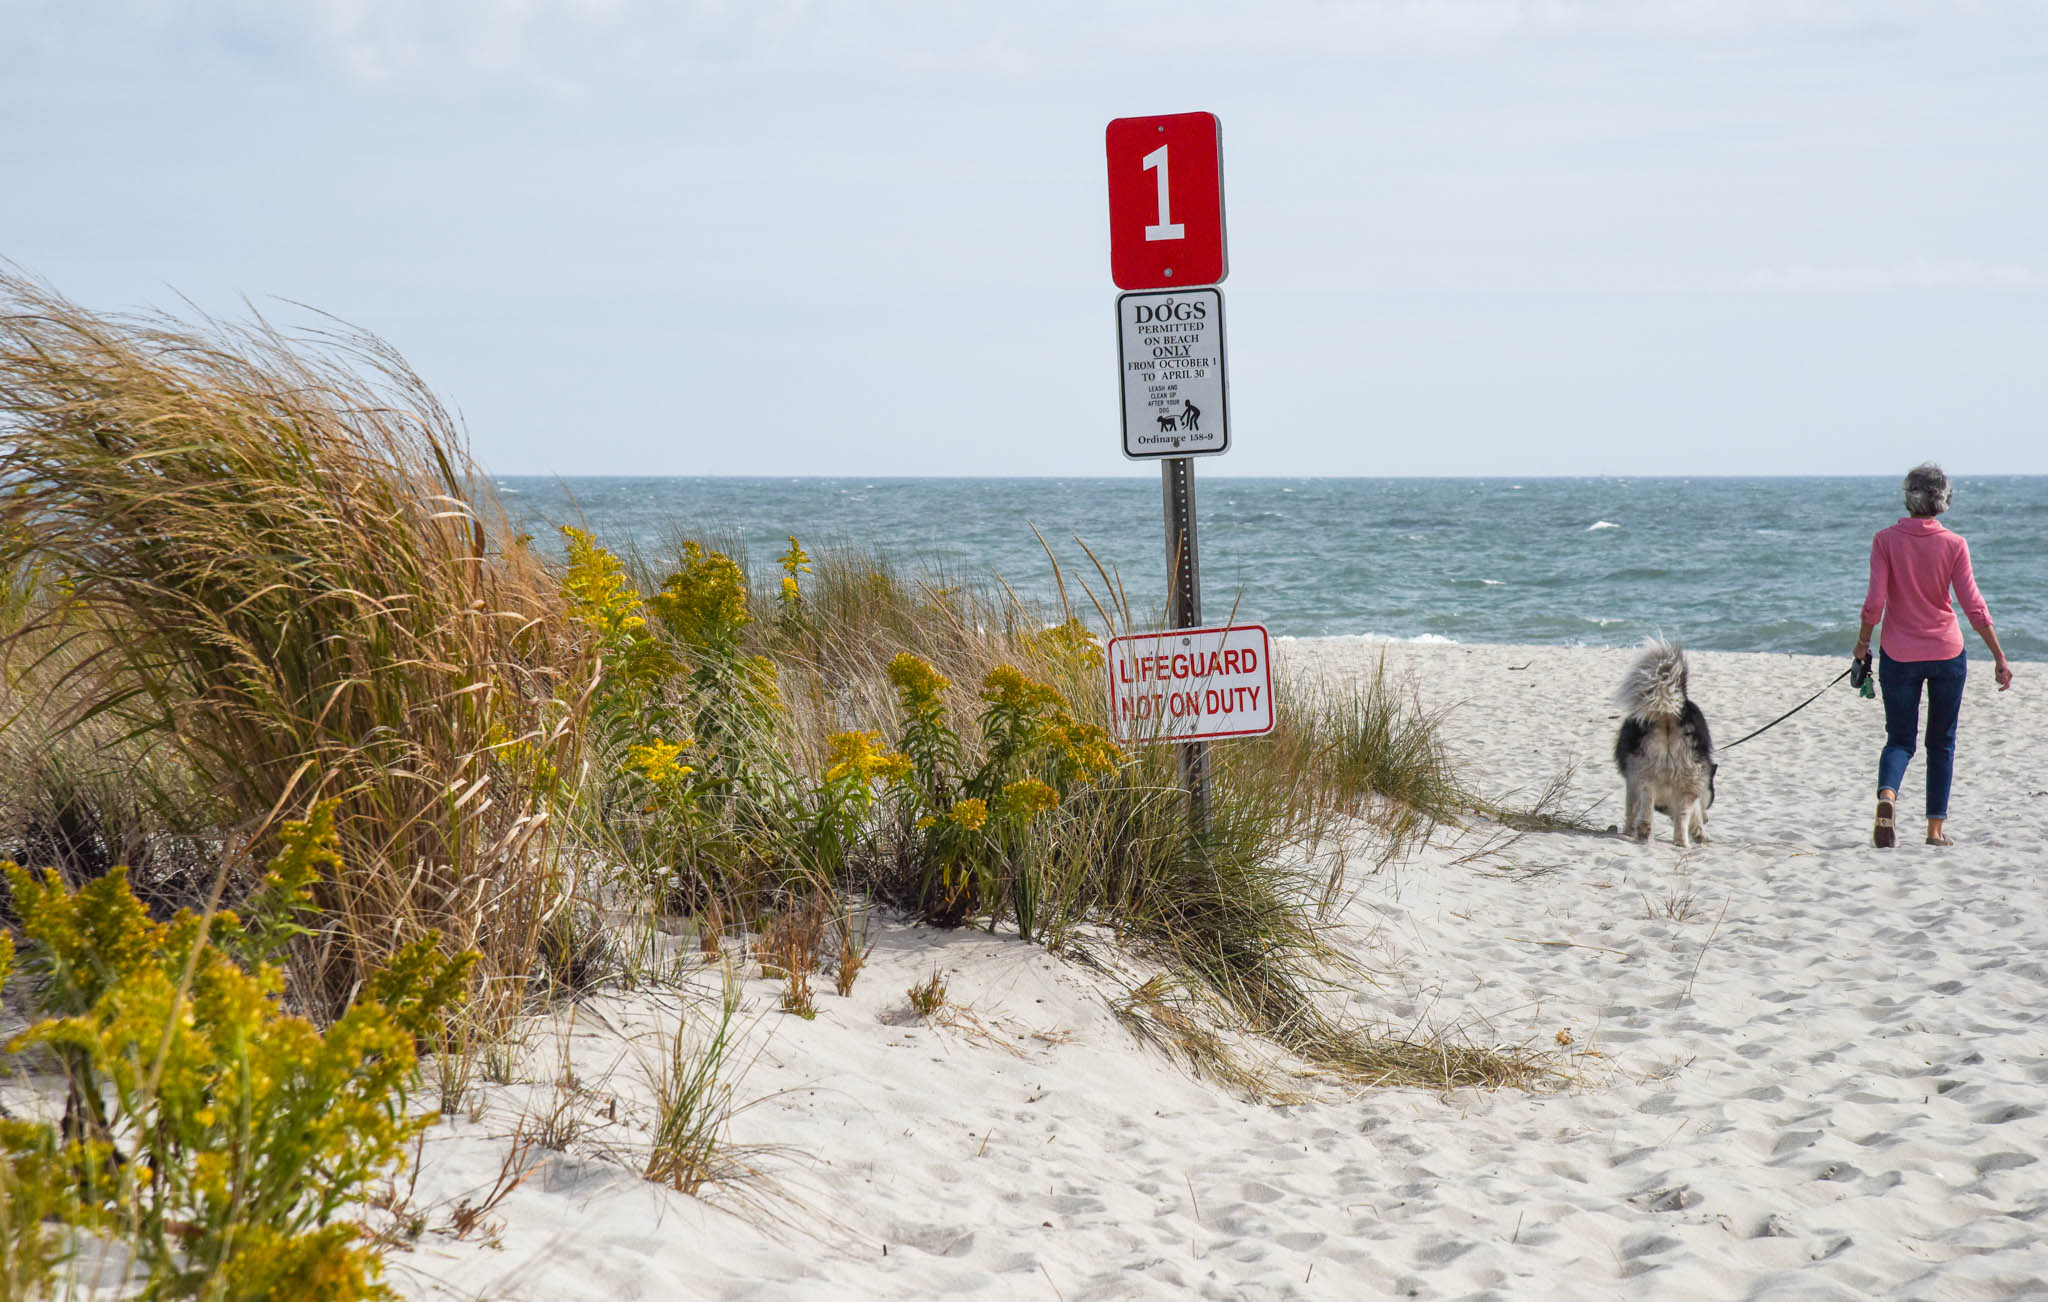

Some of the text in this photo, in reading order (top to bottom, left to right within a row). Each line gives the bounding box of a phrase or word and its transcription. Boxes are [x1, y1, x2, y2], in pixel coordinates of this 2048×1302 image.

[1143, 144, 1185, 241] 1
[1135, 301, 1206, 324] DOGS
[1138, 322, 1204, 334] PERMITTED
[1144, 334, 1199, 346] ON BEACH
[1152, 345, 1192, 358] ONLY
[1128, 357, 1217, 371] FROM OCTOBER 1
[1141, 369, 1205, 382] TO APRIL 30
[1150, 392, 1168, 400] CLEAN
[1148, 399, 1164, 407] AFTER
[1138, 433, 1214, 445] Ordinance 158-9
[1120, 648, 1258, 684] LIFEGUARD
[1121, 686, 1261, 722] NOT ON DUTY
